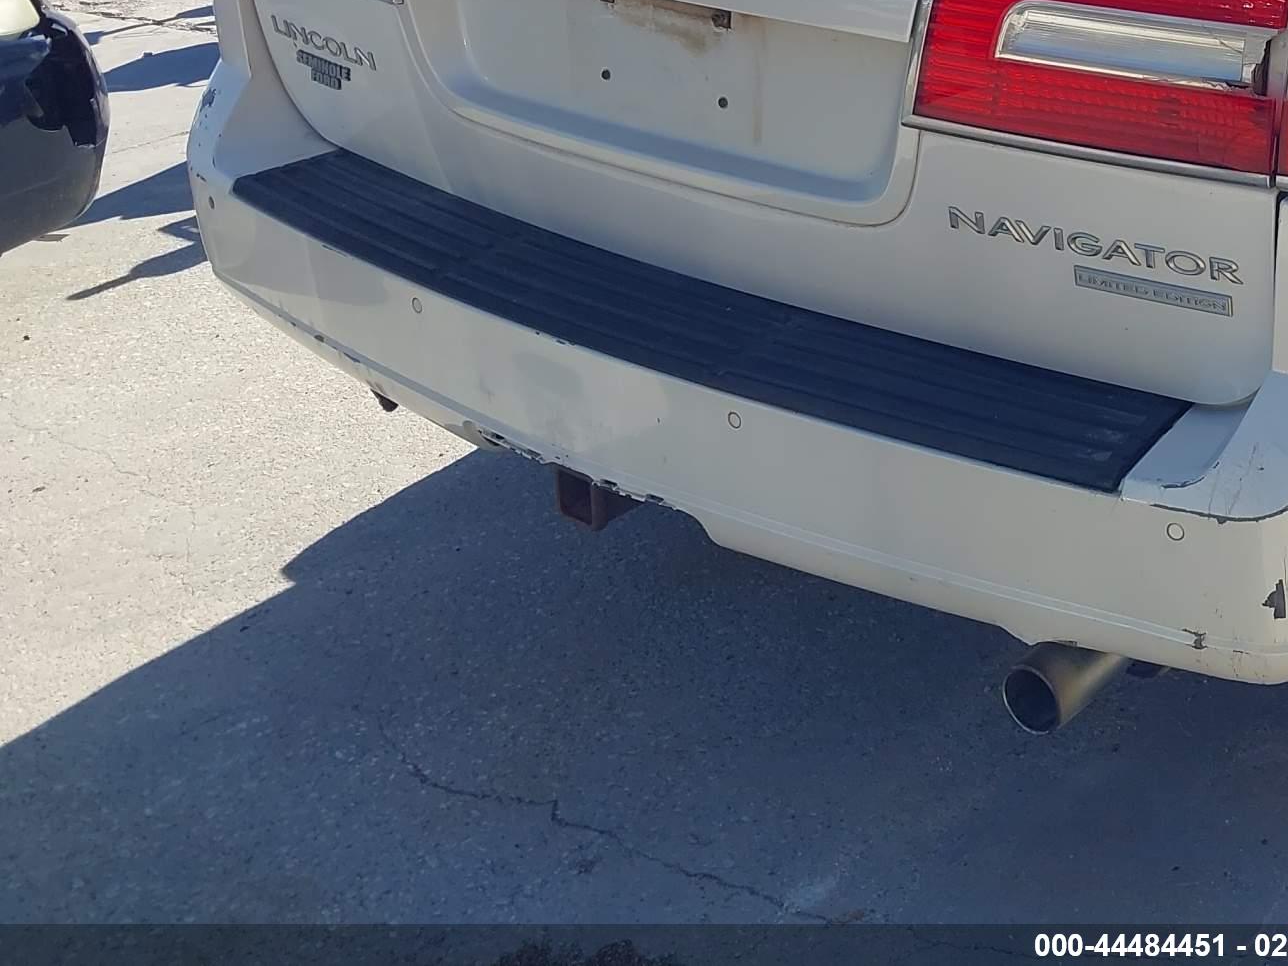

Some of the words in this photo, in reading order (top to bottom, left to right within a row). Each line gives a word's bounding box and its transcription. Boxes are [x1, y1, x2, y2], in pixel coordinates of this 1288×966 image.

[270, 14, 377, 71] LINCOLN
[311, 67, 342, 91] FORD
[948, 205, 1244, 285] NAVIGATOR
[1077, 271, 1149, 295] LIMITED
[1153, 287, 1228, 313] EDITION
